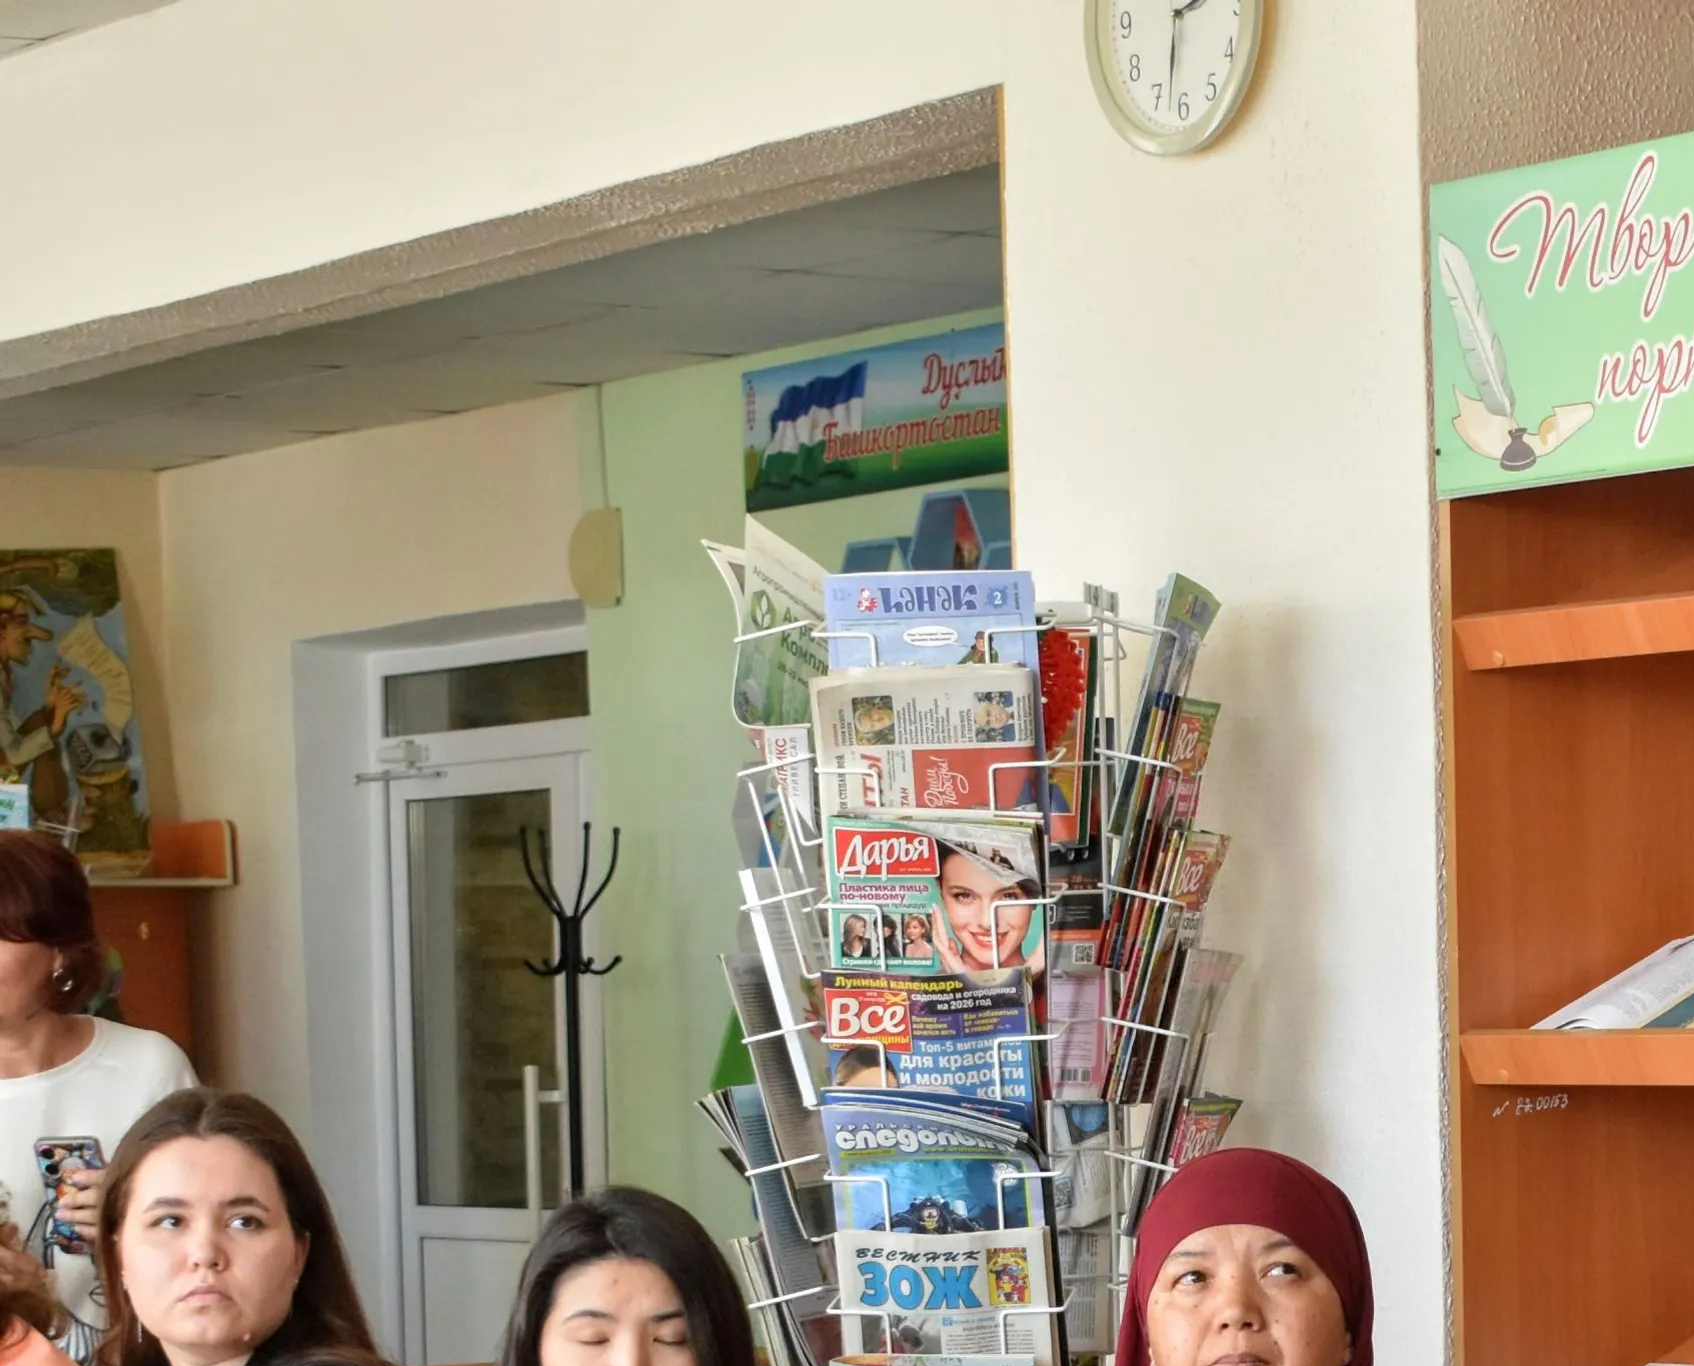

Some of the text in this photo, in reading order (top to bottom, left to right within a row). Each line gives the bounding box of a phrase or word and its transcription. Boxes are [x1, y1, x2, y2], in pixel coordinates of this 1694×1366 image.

[1120, 12, 1132, 38] 9
[1224, 36, 1234, 62] 4
[1129, 54, 1141, 81] 8
[1151, 83, 1163, 112] 7
[1205, 73, 1217, 101] 5
[1177, 92, 1190, 121] 6
[993, 591, 1003, 605] 2
[840, 835, 930, 880] Дарья
[840, 883, 929, 894] Пластика лица
[840, 893, 906, 902] по-новому
[834, 976, 963, 992] Лунный календарь
[911, 993, 954, 1002] садовода
[963, 987, 1016, 999] огородника
[976, 999, 992, 1008] год
[831, 997, 906, 1037] Все
[920, 1041, 954, 1054] Топ-5
[900, 1055, 935, 1070] для
[900, 1073, 911, 1084] и
[857, 1260, 983, 1311] ЗОЖ
